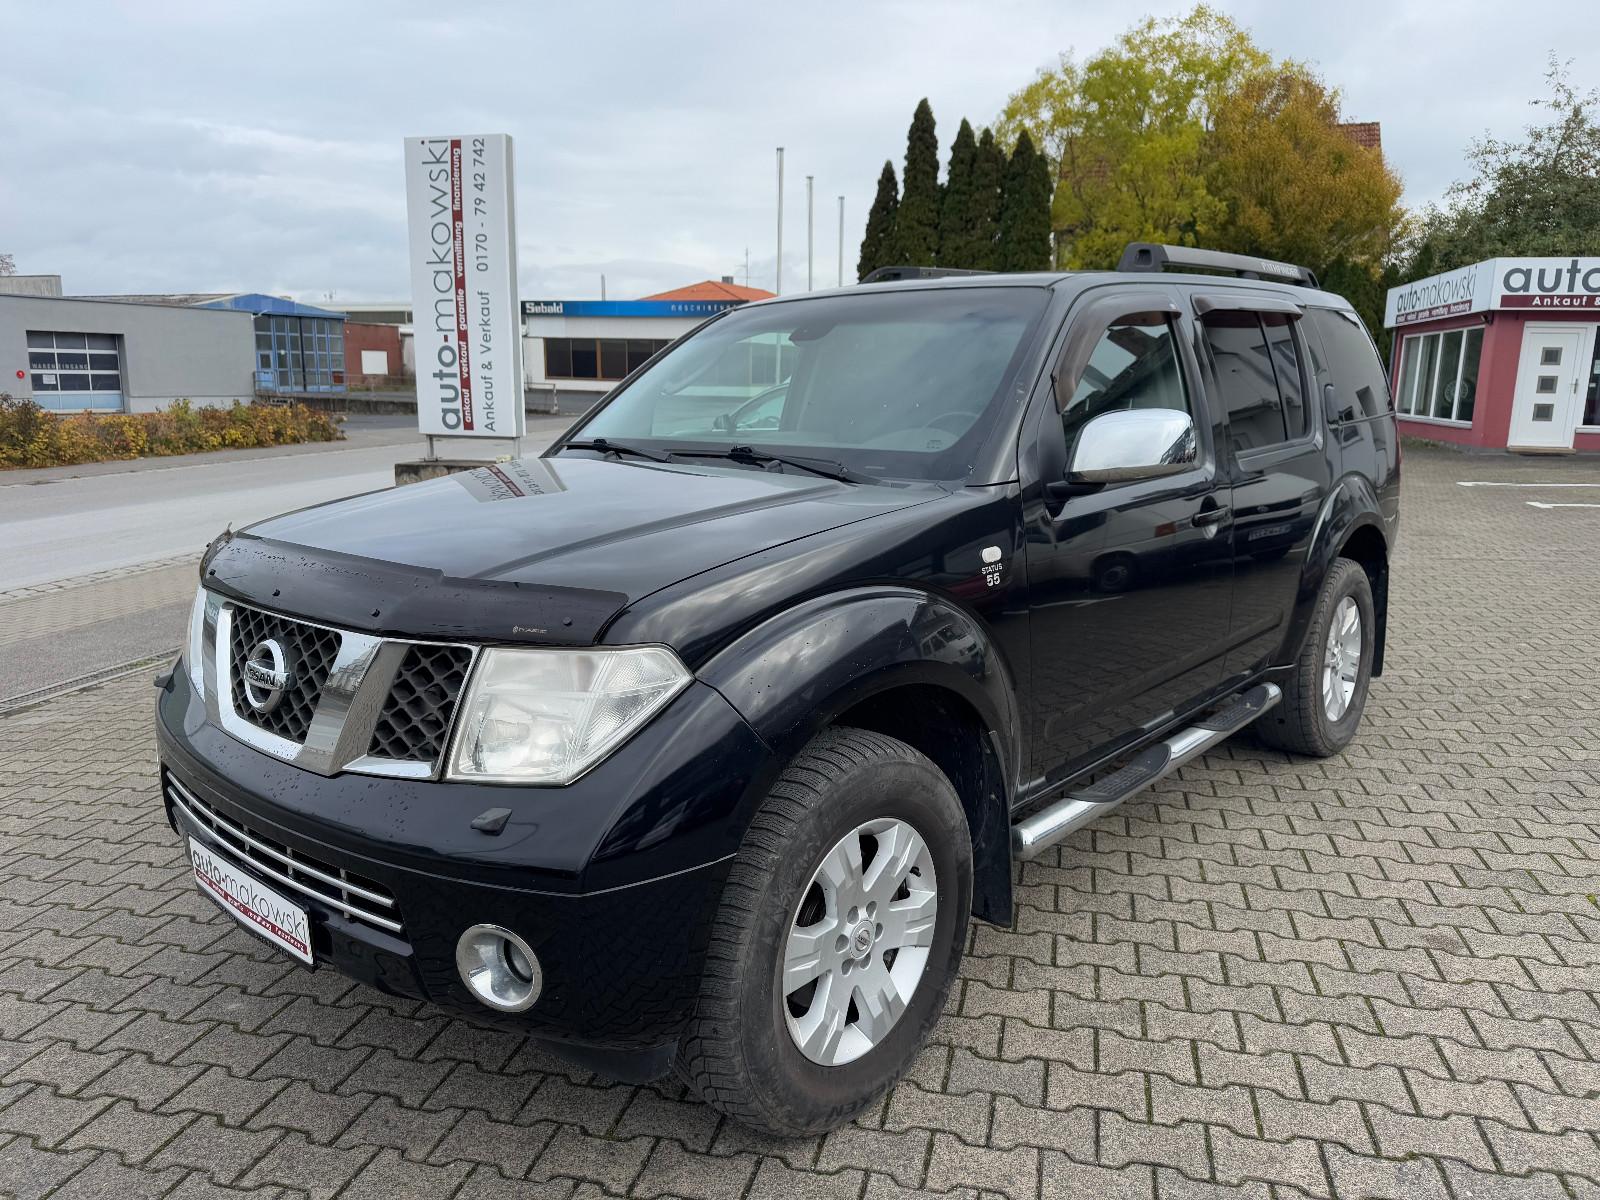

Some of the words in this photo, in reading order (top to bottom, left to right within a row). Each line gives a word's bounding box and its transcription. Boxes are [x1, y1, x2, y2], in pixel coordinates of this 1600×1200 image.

[472, 138, 485, 167] 742
[452, 148, 462, 211] finanzierung
[473, 172, 486, 192] 42
[474, 197, 487, 216] 79
[453, 221, 464, 278] vermittlung
[475, 233, 488, 272] 0170
[421, 139, 461, 430] auto-makowski
[1397, 264, 1478, 313] auto-makowski
[1532, 296, 1588, 306] Ankauf
[456, 288, 467, 331] garantie
[477, 290, 491, 354] Verkauf
[459, 341, 469, 378] verkauf
[481, 361, 493, 371] &
[462, 388, 472, 423] ankauf
[481, 375, 496, 432] Ankauf
[981, 563, 1003, 575] STATUS
[986, 572, 1000, 587] 55
[192, 849, 308, 943] auto-makowski
